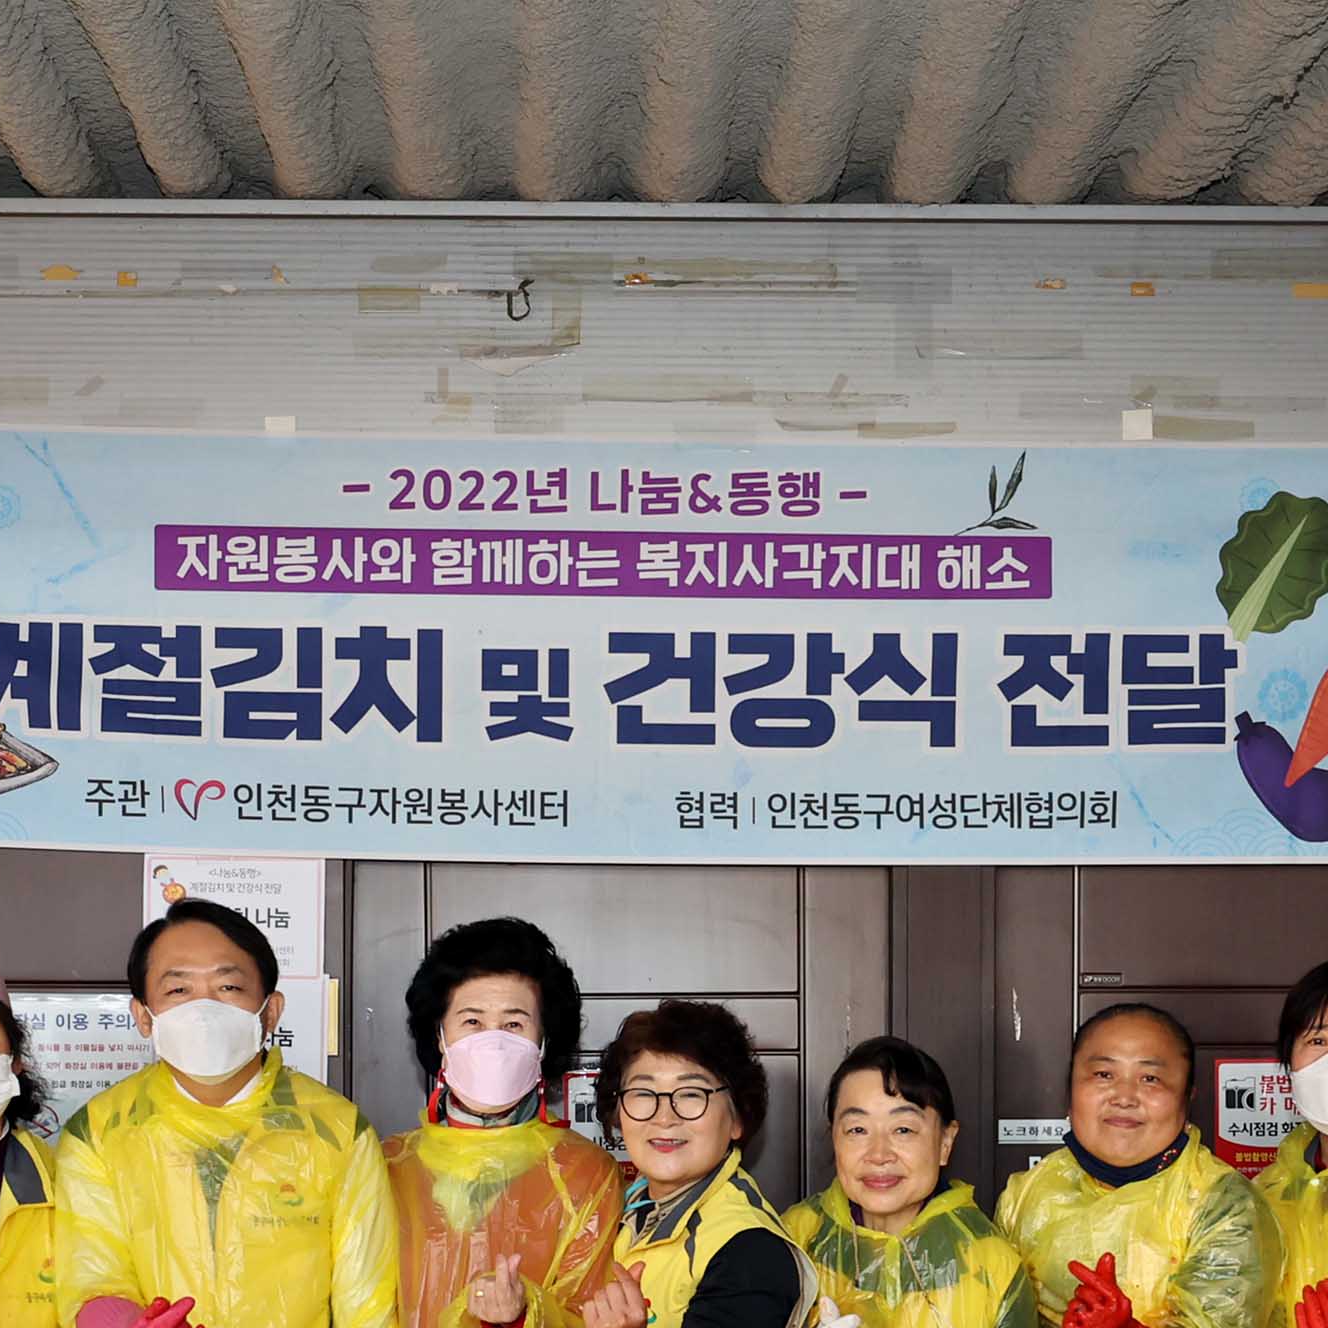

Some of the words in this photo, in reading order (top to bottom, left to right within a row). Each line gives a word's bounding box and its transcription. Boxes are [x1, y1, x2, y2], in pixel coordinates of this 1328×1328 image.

[388, 467, 568, 514] 2022년
[590, 468, 821, 518] 나눔&동행
[176, 534, 417, 584] 자원봉사와
[430, 538, 621, 588] 함께하는
[636, 540, 921, 590] 복지사각지대
[936, 544, 1031, 590] 해소
[480, 647, 574, 742] 및
[602, 631, 959, 749] 건강식
[996, 631, 1238, 749] 전달
[84, 778, 151, 818] 주관
[233, 783, 568, 828] 인천동구자원봉사센터
[674, 791, 738, 830] 협력
[767, 790, 1118, 830] 인천동구여성단체협의회
[254, 907, 291, 929] 나눔
[55, 1013, 89, 1031] 이용
[97, 1013, 136, 1031] 주의
[1228, 1121, 1279, 1137] 수시점검
